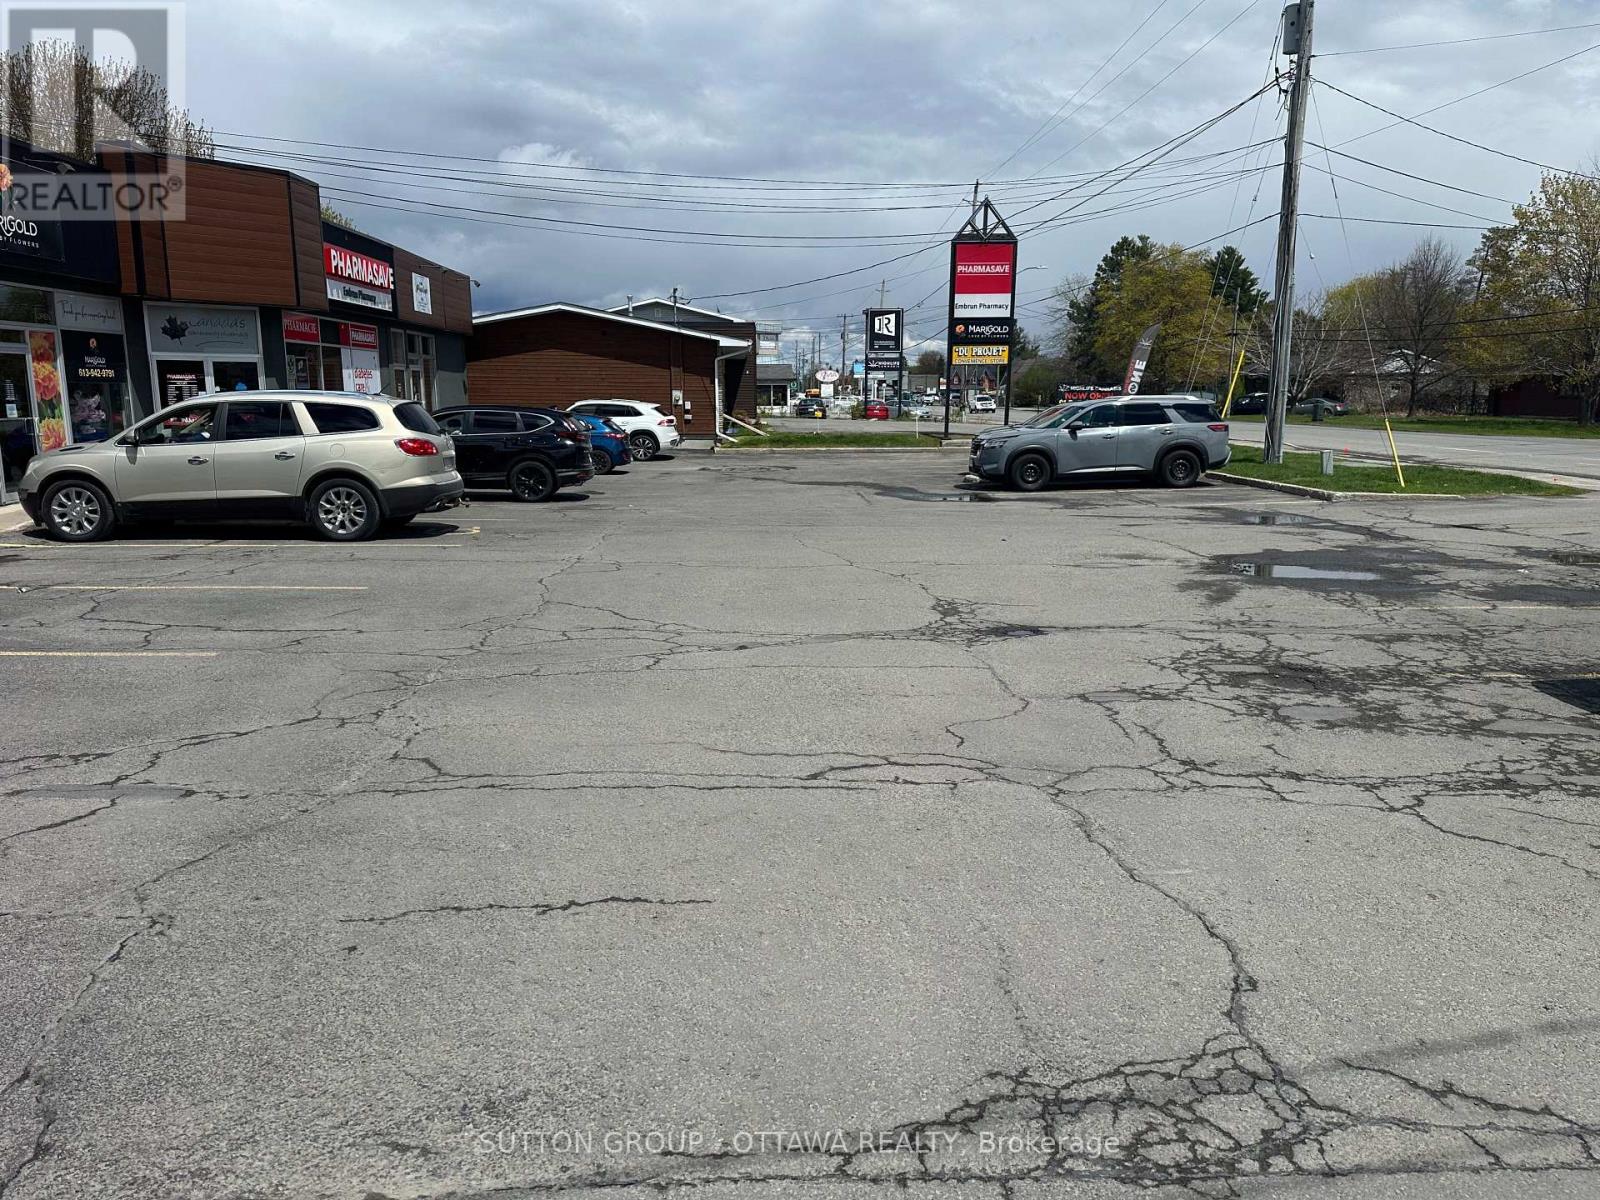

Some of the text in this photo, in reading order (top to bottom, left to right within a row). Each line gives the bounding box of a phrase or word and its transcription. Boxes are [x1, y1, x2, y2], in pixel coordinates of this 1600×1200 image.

[330, 248, 395, 290] PHARMASAVE
[957, 264, 1010, 274] PHARMASAVE
[954, 302, 1009, 311] Embrun Pharmacy
[968, 324, 1009, 336] MARIGOLD
